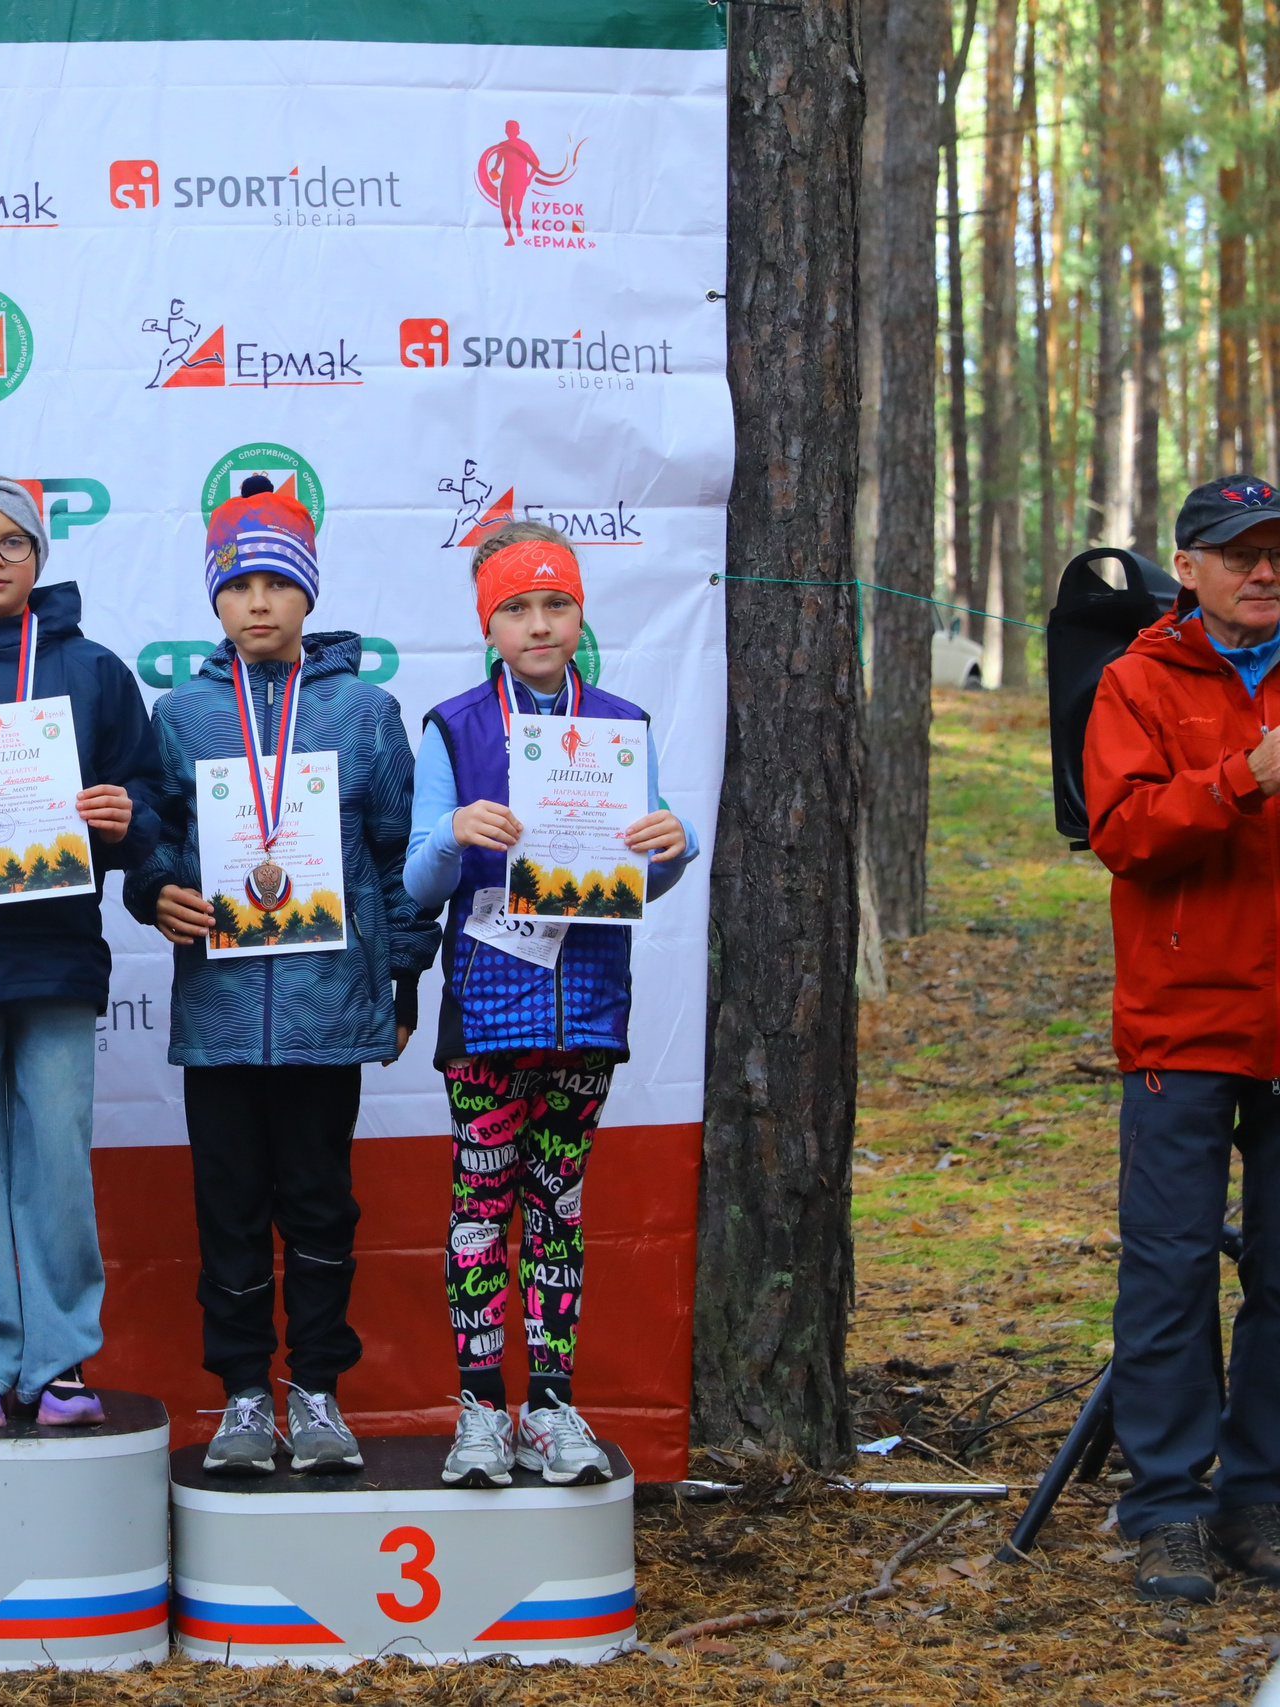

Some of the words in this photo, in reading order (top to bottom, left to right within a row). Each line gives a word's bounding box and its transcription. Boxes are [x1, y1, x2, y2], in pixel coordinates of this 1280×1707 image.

[174, 166, 402, 208] SPORTident
[274, 209, 356, 227] siberia
[531, 202, 584, 216] КУБОК
[531, 219, 566, 232] КСО
[523, 235, 597, 250] «ЕРМАК»
[5, 313, 28, 388] ОРИЕНТИРОВАНИЯ
[236, 339, 362, 387] Ермак
[463, 328, 673, 375] SPORTident
[558, 373, 635, 391] siberia
[207, 459, 235, 506] ФЕДЕРАЦИЯ
[238, 448, 299, 467] СПОРТИВНОГО
[547, 769, 614, 784] ДИПЛОМ
[553, 789, 609, 797] НАГРАЖДАЕТСЯ
[451, 1081, 498, 1111] love
[460, 1266, 508, 1297] love
[376, 1525, 441, 1623] 3
